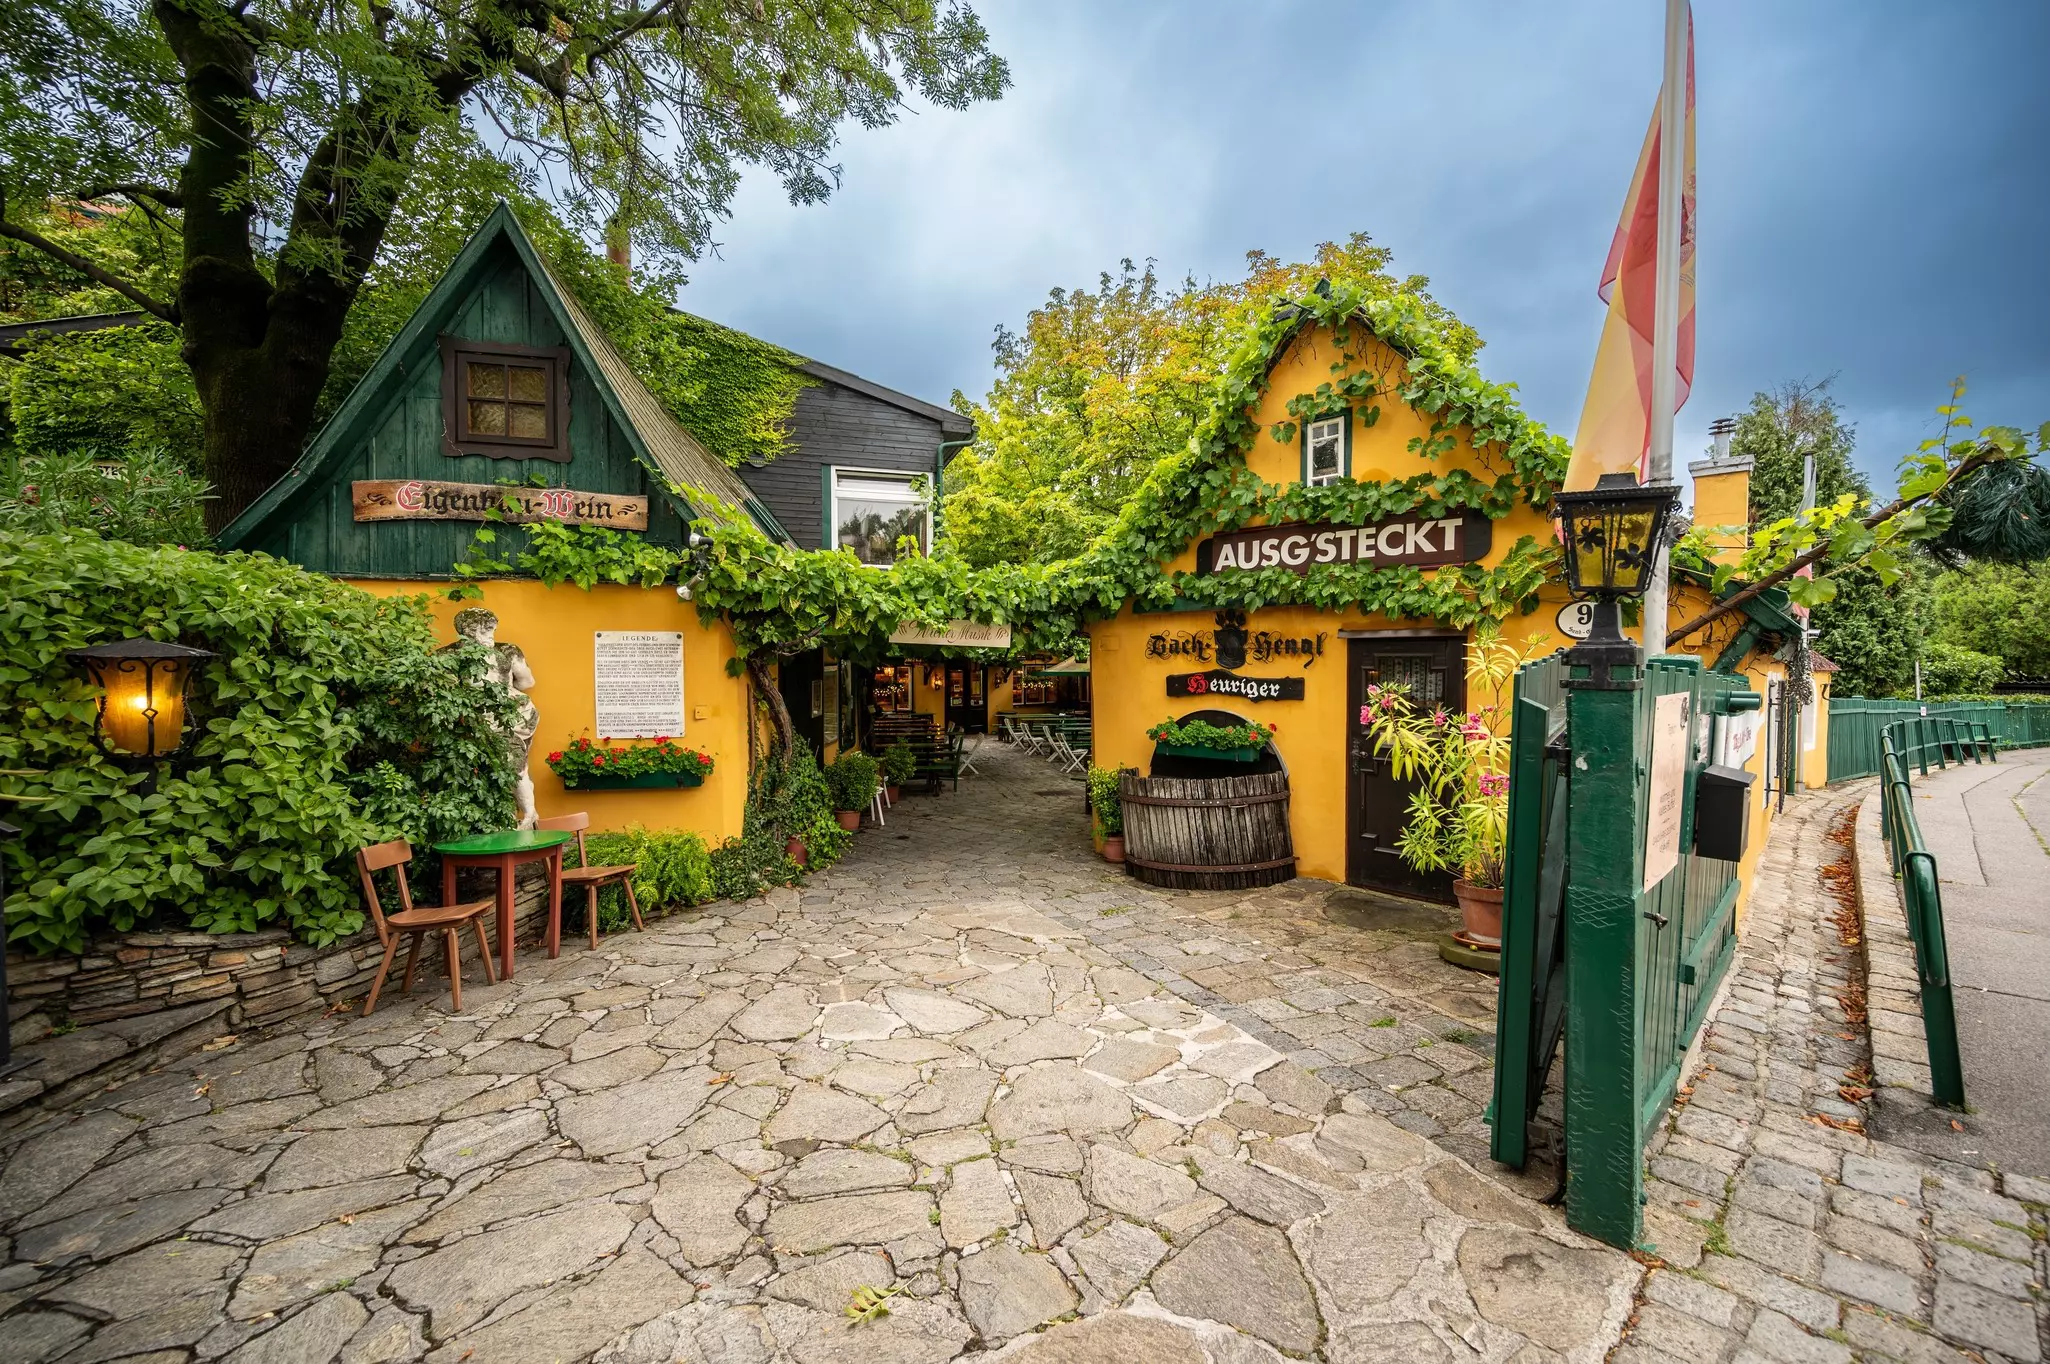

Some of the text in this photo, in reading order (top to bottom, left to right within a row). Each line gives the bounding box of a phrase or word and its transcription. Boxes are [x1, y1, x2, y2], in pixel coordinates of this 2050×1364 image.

[1214, 517, 1463, 572] AUSG'STECKT
[1577, 603, 1593, 625] 9
[958, 624, 993, 641] Musik
[1246, 631, 1327, 669] Hengl
[1186, 673, 1281, 698] Heuriger
